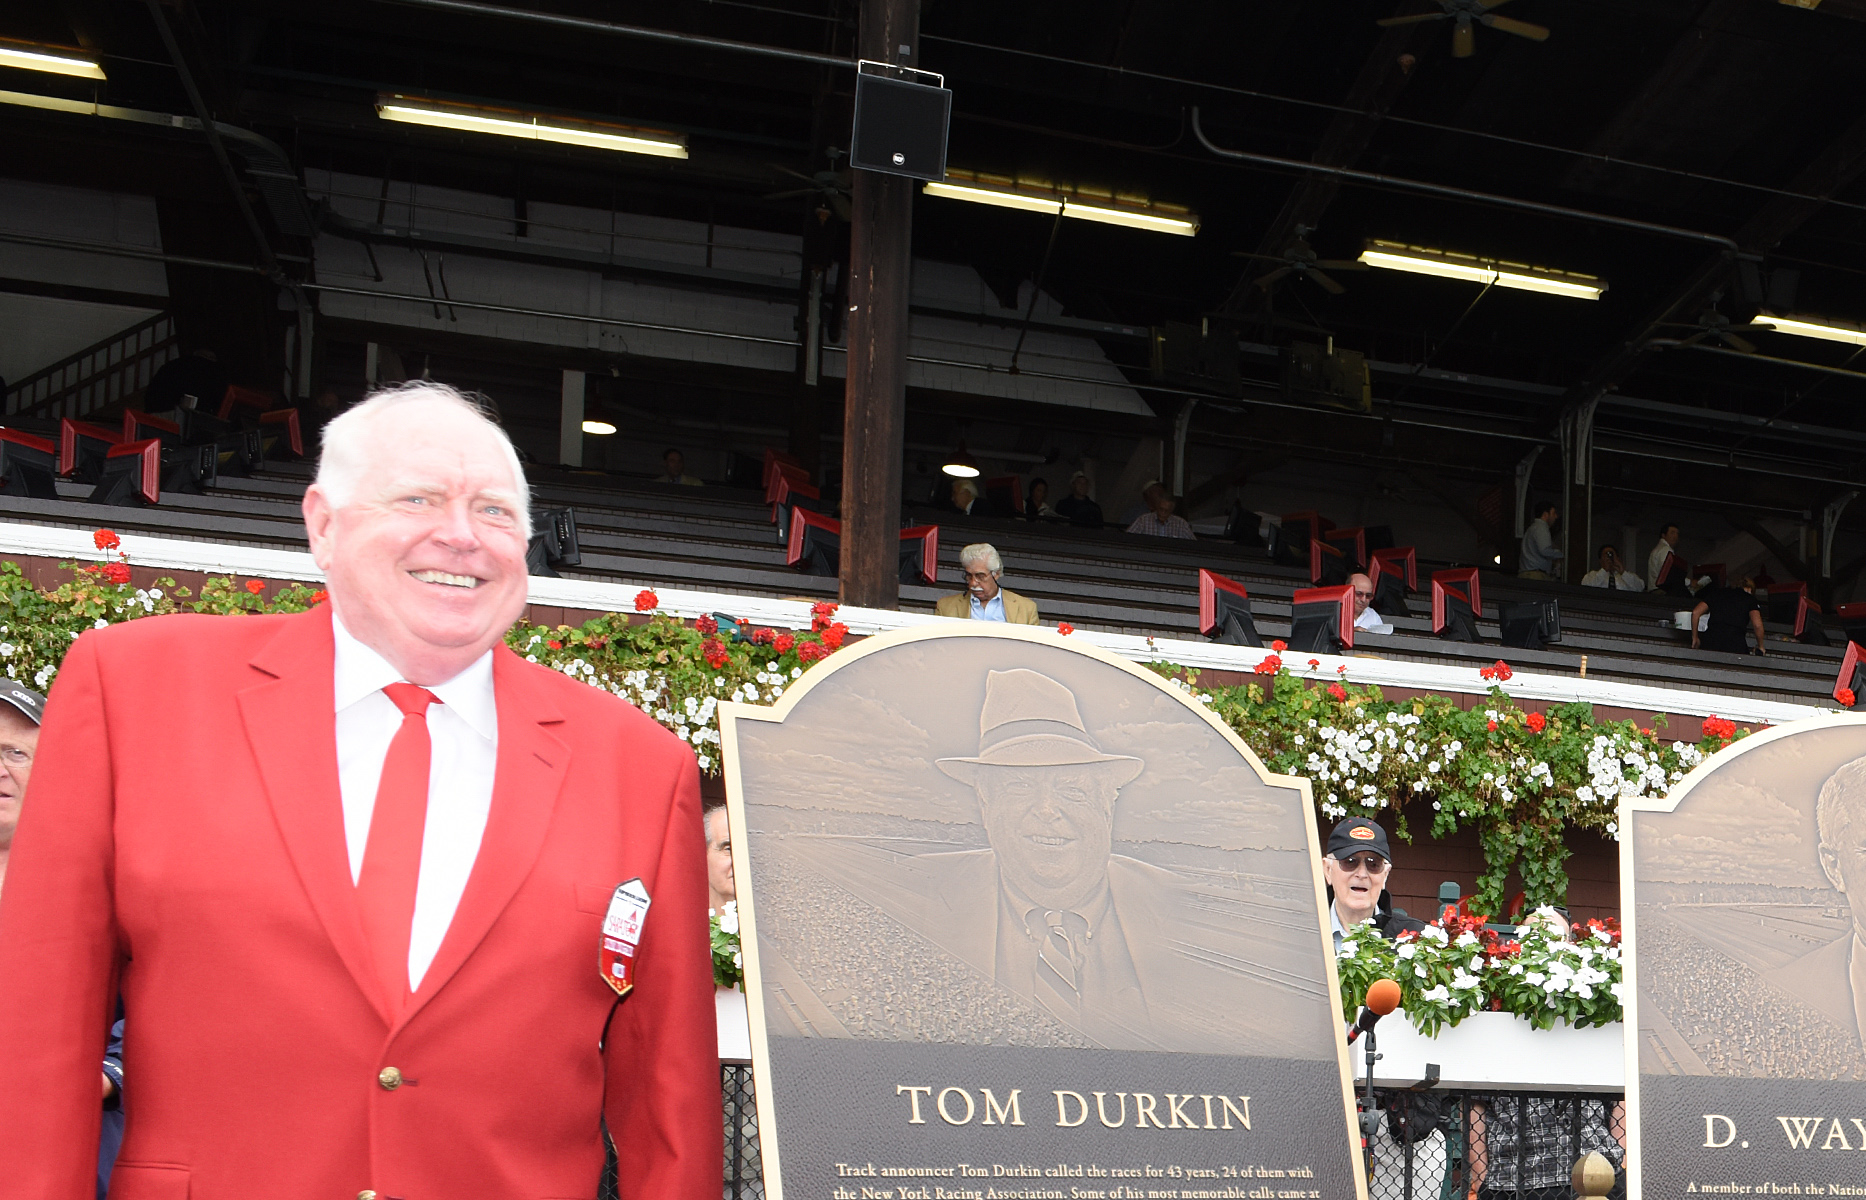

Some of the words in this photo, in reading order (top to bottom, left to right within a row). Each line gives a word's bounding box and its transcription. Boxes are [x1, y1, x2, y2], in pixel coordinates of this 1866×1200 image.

[897, 1084, 1026, 1125] TOM
[1052, 1090, 1251, 1130] DURKIN
[1702, 1114, 1749, 1148] D.
[835, 1163, 877, 1177] Track
[881, 1167, 955, 1176] announcer
[958, 1164, 990, 1177] Tom
[993, 1164, 1042, 1177] Durkin
[1045, 1164, 1084, 1177] called
[1087, 1164, 1108, 1177] the
[1111, 1169, 1142, 1177] races
[1145, 1164, 1164, 1177] for
[1167, 1165, 1182, 1178] 43
[1185, 1169, 1220, 1181] years,
[1222, 1165, 1238, 1178] 24
[1241, 1165, 1254, 1178] of
[1256, 1166, 1285, 1178] them
[1287, 1166, 1313, 1178] with
[833, 1186, 857, 1200] the
[861, 1187, 894, 1200] New
[897, 1186, 932, 1200] York
[986, 1187, 1068, 1199] Association.
[1071, 1186, 1106, 1199] Some
[1109, 1186, 1124, 1199] of
[1125, 1186, 1145, 1199] his
[1148, 1190, 1178, 1199] most
[1181, 1186, 1246, 1199] memorable
[1249, 1186, 1275, 1199] calls
[1278, 1190, 1306, 1199] came
[1309, 1190, 1320, 1198] at
[1686, 1181, 1698, 1193] A
[1702, 1182, 1752, 1195] member
[1755, 1182, 1770, 1194] of
[1772, 1182, 1801, 1194] both
[1805, 1183, 1825, 1195] the
